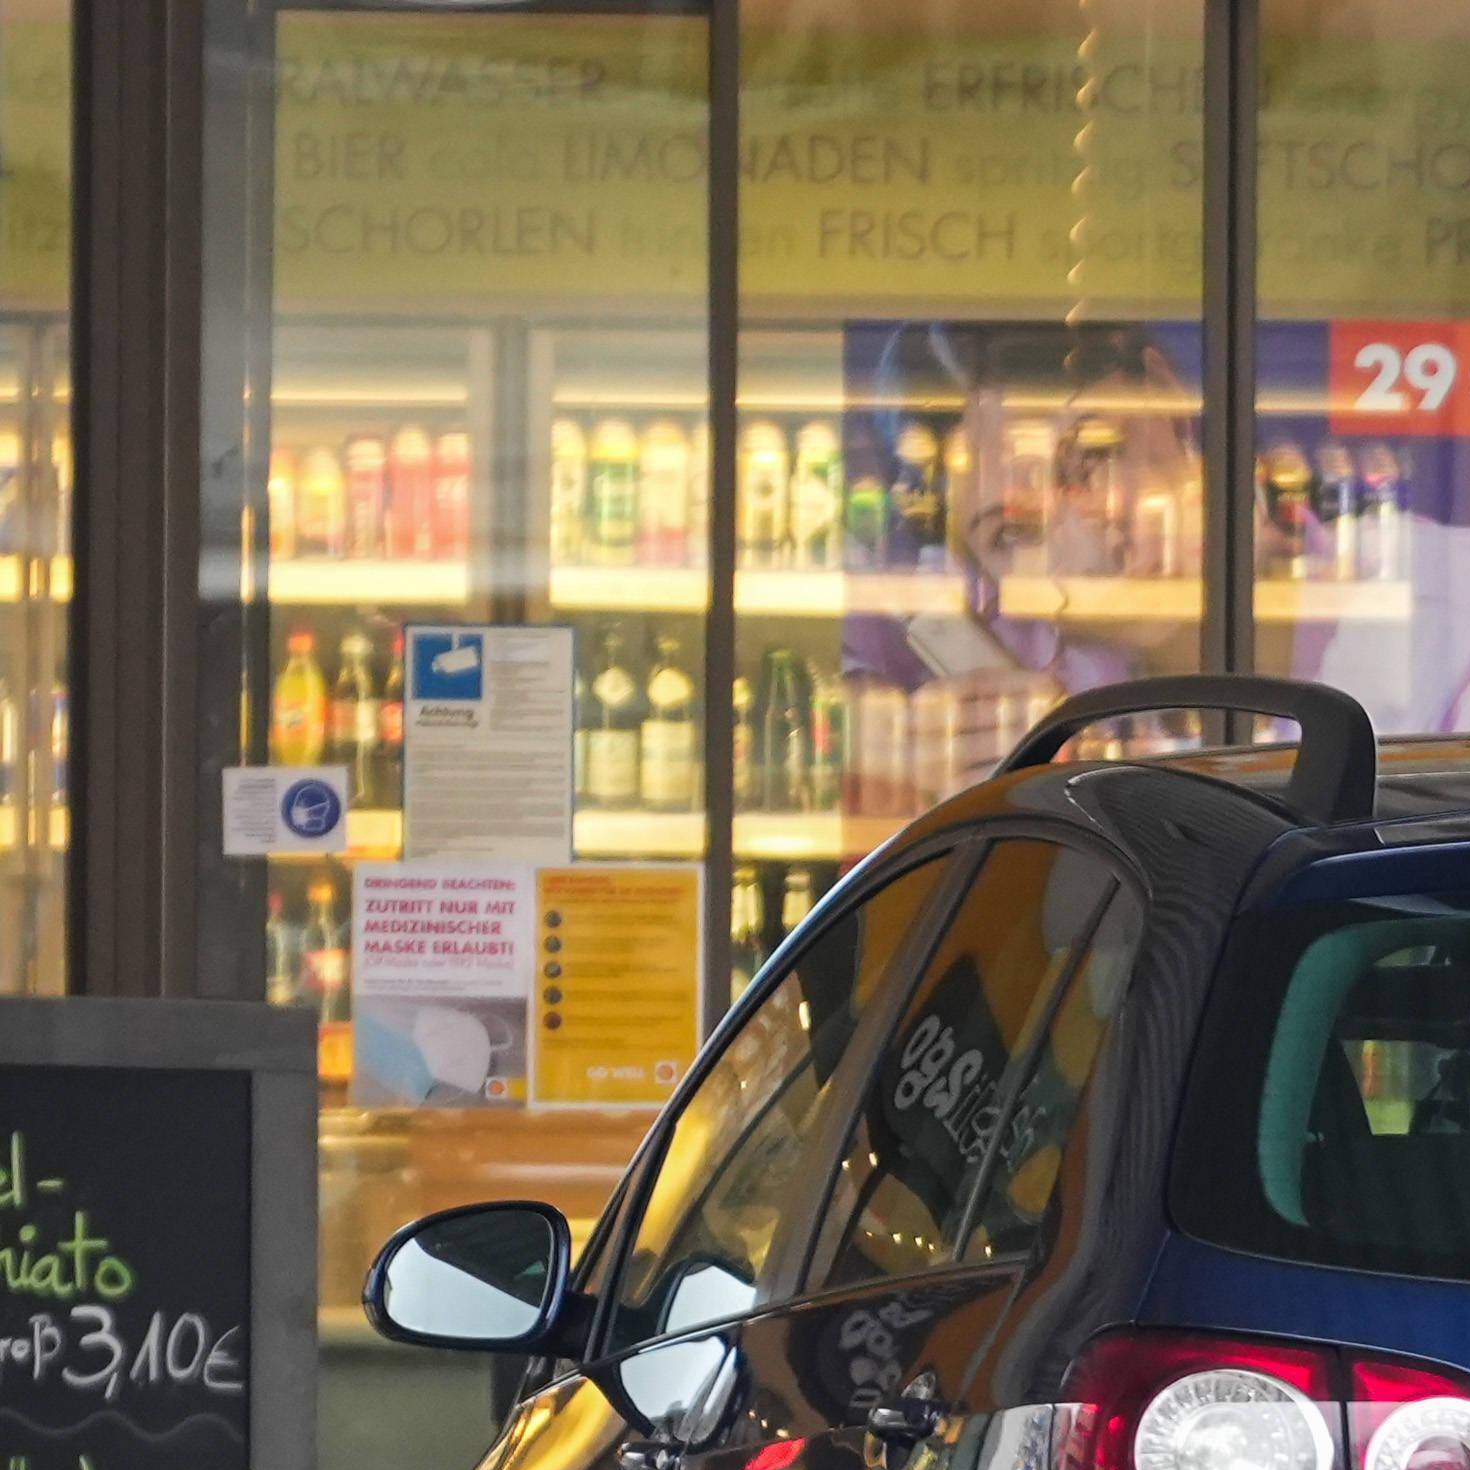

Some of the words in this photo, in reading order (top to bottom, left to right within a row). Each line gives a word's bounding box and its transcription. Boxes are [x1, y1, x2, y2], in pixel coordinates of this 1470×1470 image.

[293, 132, 404, 181] BIER
[281, 204, 596, 258] SCHORLEN
[816, 208, 1018, 264] FRISCH
[1353, 342, 1457, 411] 29
[365, 899, 434, 914] ZUTRITT
[439, 900, 478, 914] NUR
[484, 901, 516, 914] MIT
[364, 920, 503, 935] MEDIZINISCHER
[364, 940, 426, 954] MASKE
[432, 941, 515, 955] ERLAUBT!
